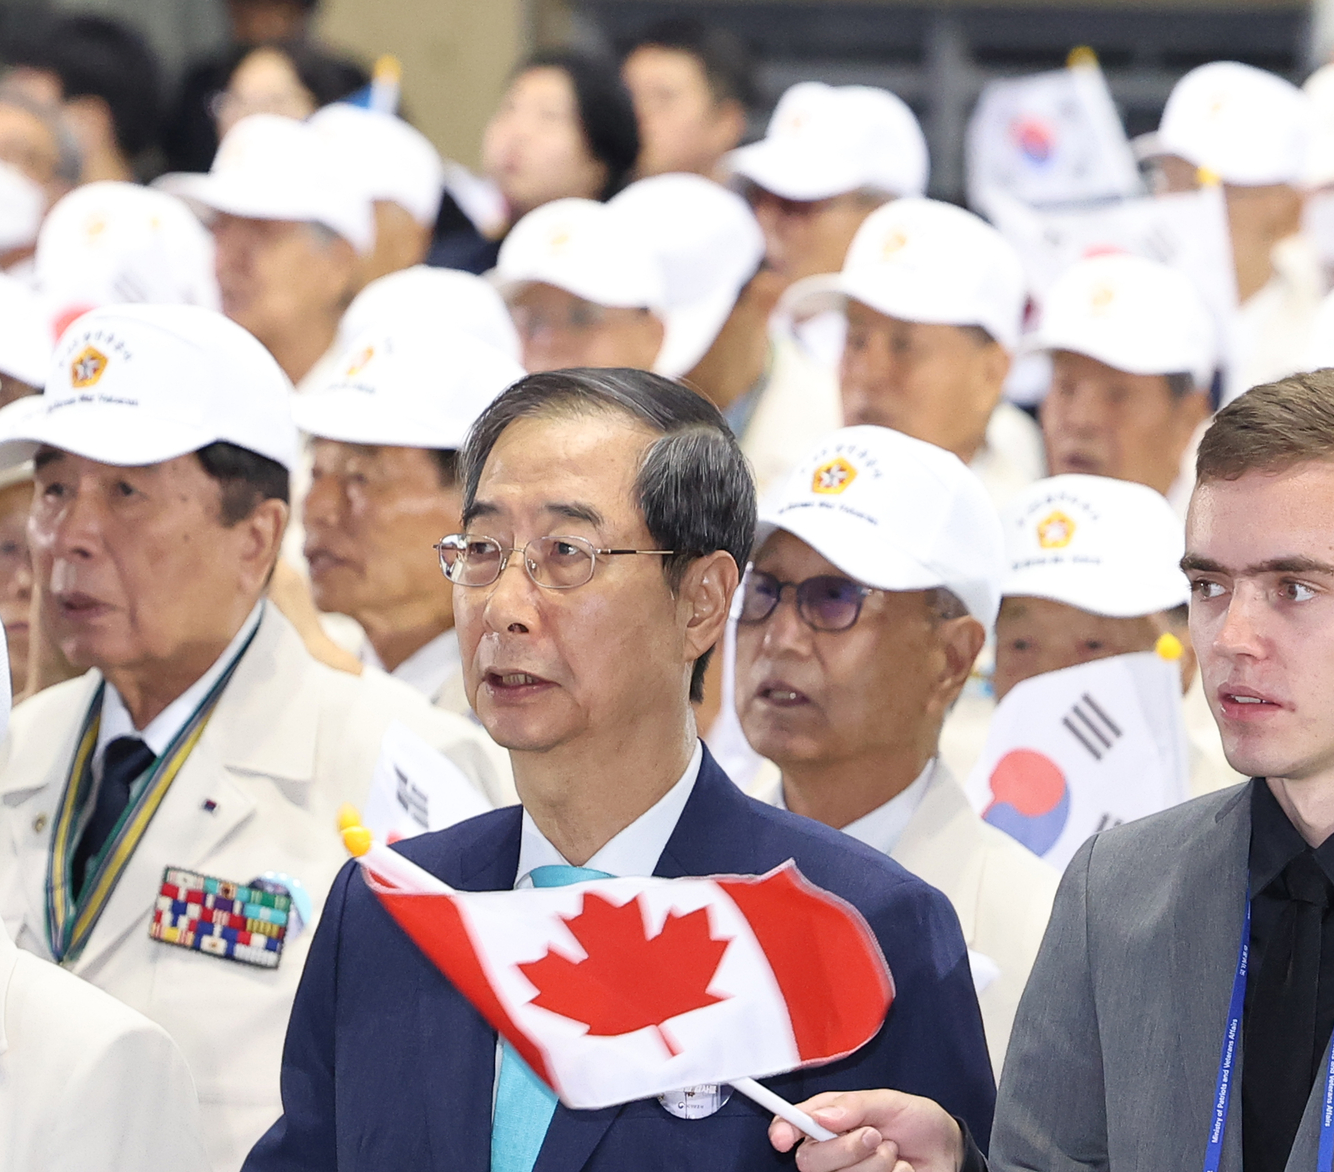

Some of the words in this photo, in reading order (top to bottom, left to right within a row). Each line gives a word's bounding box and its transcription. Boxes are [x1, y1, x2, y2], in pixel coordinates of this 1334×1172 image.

[1228, 1019, 1238, 1040] Affairs
[1223, 1040, 1234, 1069] Veterans
[1221, 1069, 1230, 1083] and
[1217, 1083, 1228, 1109] Patriots
[1324, 1105, 1333, 1127] Affairs
[1211, 1117, 1223, 1143] Ministry
